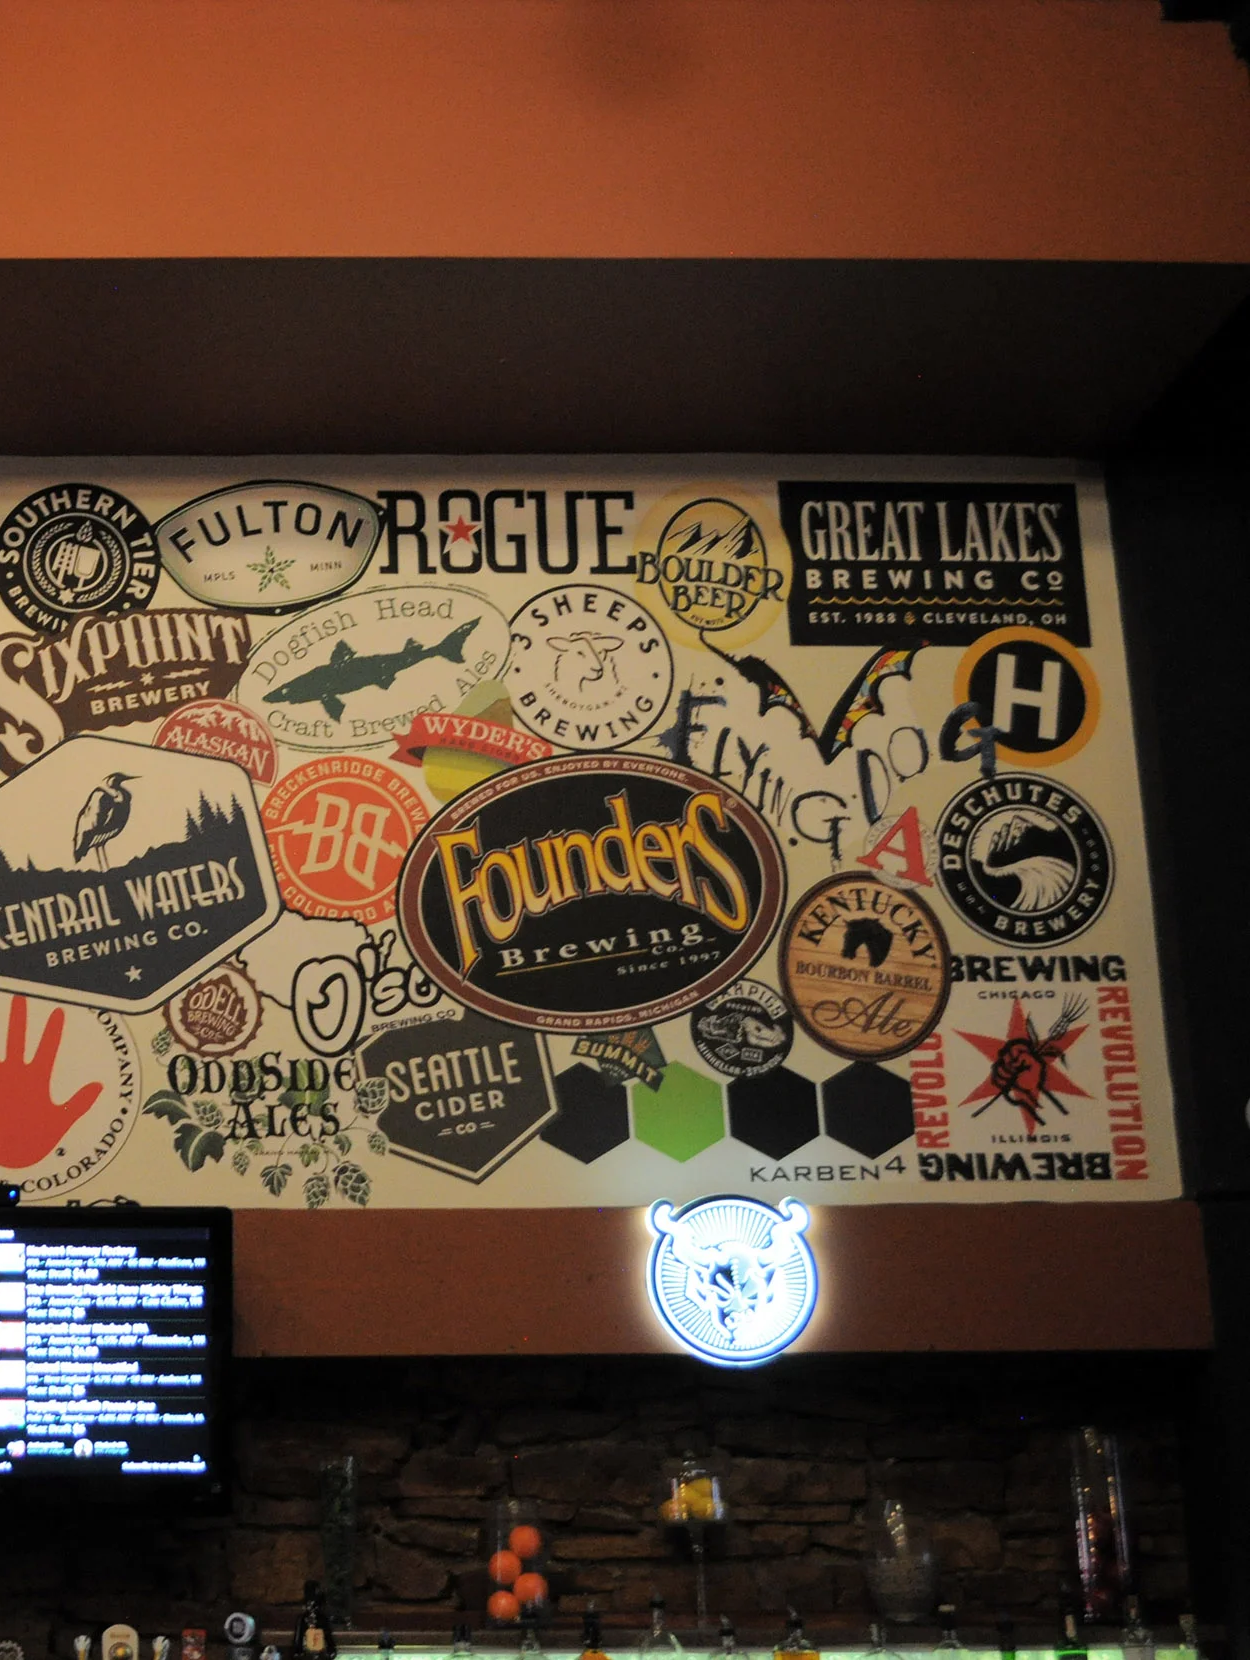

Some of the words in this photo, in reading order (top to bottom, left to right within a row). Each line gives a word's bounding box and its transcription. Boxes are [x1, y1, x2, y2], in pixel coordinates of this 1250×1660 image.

[169, 499, 366, 564] FULTON
[377, 488, 638, 576] ROGUE
[800, 500, 924, 563] GREAT
[939, 501, 1066, 564] LAKES
[124, 532, 157, 600] TIER
[202, 569, 237, 584] MPLS
[309, 558, 344, 573] MINN
[636, 551, 785, 602] BOULDER
[805, 568, 995, 592] BREWING
[8, 585, 69, 632] BREWI
[510, 631, 533, 652] 3
[530, 593, 660, 655] SHEEPS
[670, 584, 747, 618] BEER
[808, 611, 846, 626] EST.
[854, 611, 898, 626] 1988
[922, 611, 1036, 628] CLEVELAND,
[1041, 613, 1068, 626] OH
[252, 610, 359, 687] Dogfish
[374, 597, 455, 621] Head
[91, 680, 211, 716] BREWERY
[267, 709, 334, 739] Craft
[349, 693, 448, 738] Brewed
[455, 649, 498, 698] Ales
[519, 693, 655, 743] BREWING
[993, 652, 1064, 741] H
[160, 725, 271, 777] ALASKAN
[422, 716, 547, 761] WYDER'S
[265, 760, 386, 820] BRECKENRIDGE
[388, 778, 426, 832] BREW
[450, 788, 494, 821] BREWED
[495, 777, 519, 792] FOR
[520, 769, 542, 783] US.
[544, 760, 600, 775] ENJOYED
[602, 760, 620, 770] BY
[622, 760, 690, 783] EVERYONE.
[662, 686, 851, 864] FLYING
[856, 700, 1002, 826] DOG
[856, 804, 934, 888] A
[942, 782, 1084, 871] DESCHUTES
[125, 856, 247, 921] WATERS
[993, 876, 1101, 936] BREWERY
[46, 928, 158, 969] BREWING
[167, 920, 209, 943] CO.
[499, 921, 706, 970] Brewing
[798, 886, 937, 962] KENTUCKY
[616, 960, 670, 976] Since
[679, 951, 722, 966] 1997
[650, 944, 686, 956] Co.
[949, 955, 1127, 983] BREWING
[795, 960, 870, 984] BOURBON
[874, 970, 934, 993] BARREL
[977, 989, 1057, 1000] CHICAGO
[187, 1010, 236, 1037] BREWING
[189, 984, 239, 1025] ODELL
[370, 1014, 433, 1034] BREWING
[442, 1008, 458, 1021] CO
[535, 1014, 581, 1027] GRAND
[584, 1012, 638, 1027] RAPIDS,
[638, 989, 701, 1018] MICHIGAN
[811, 990, 917, 1040] Ale
[384, 1041, 523, 1103] SEATTLE
[576, 1040, 658, 1083] SUMMIT
[909, 1031, 950, 1149] REVOLU
[1096, 985, 1149, 1181] REVOLUTION
[224, 1099, 342, 1141] ALES
[414, 1090, 507, 1122] CIDER
[454, 1121, 477, 1136] CO
[21, 1117, 126, 1194] COLORADO
[990, 1133, 1072, 1144] ILLINOIS
[916, 1151, 1112, 1182] BREWING
